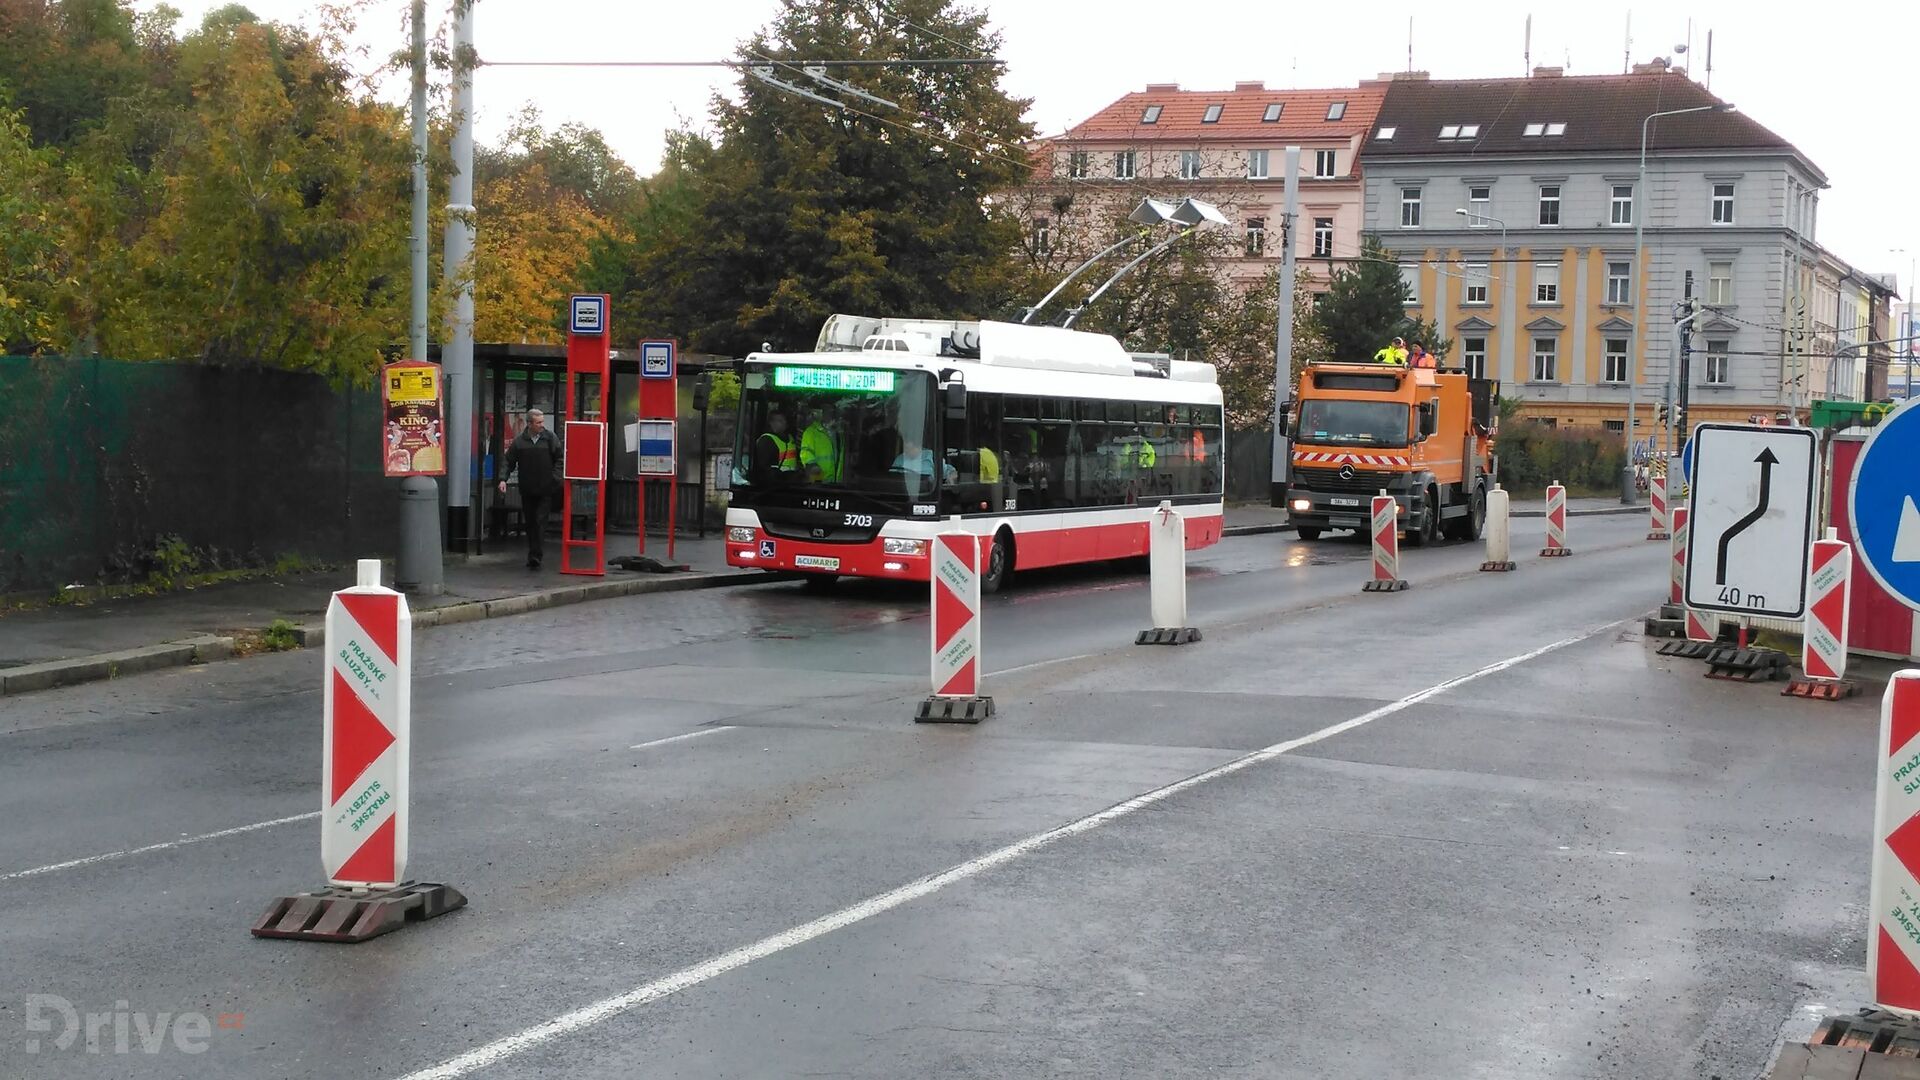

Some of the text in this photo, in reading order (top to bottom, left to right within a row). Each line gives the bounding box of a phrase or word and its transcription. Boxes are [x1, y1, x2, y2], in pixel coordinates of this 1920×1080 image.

[399, 416, 429, 426] KING
[844, 514, 872, 527] 3703
[1718, 587, 1765, 609] 40 m
[348, 640, 386, 682] PRAŽSKÉ
[1893, 752, 1920, 782] PRAŽ
[351, 791, 391, 832] PRAŽSKÉ
